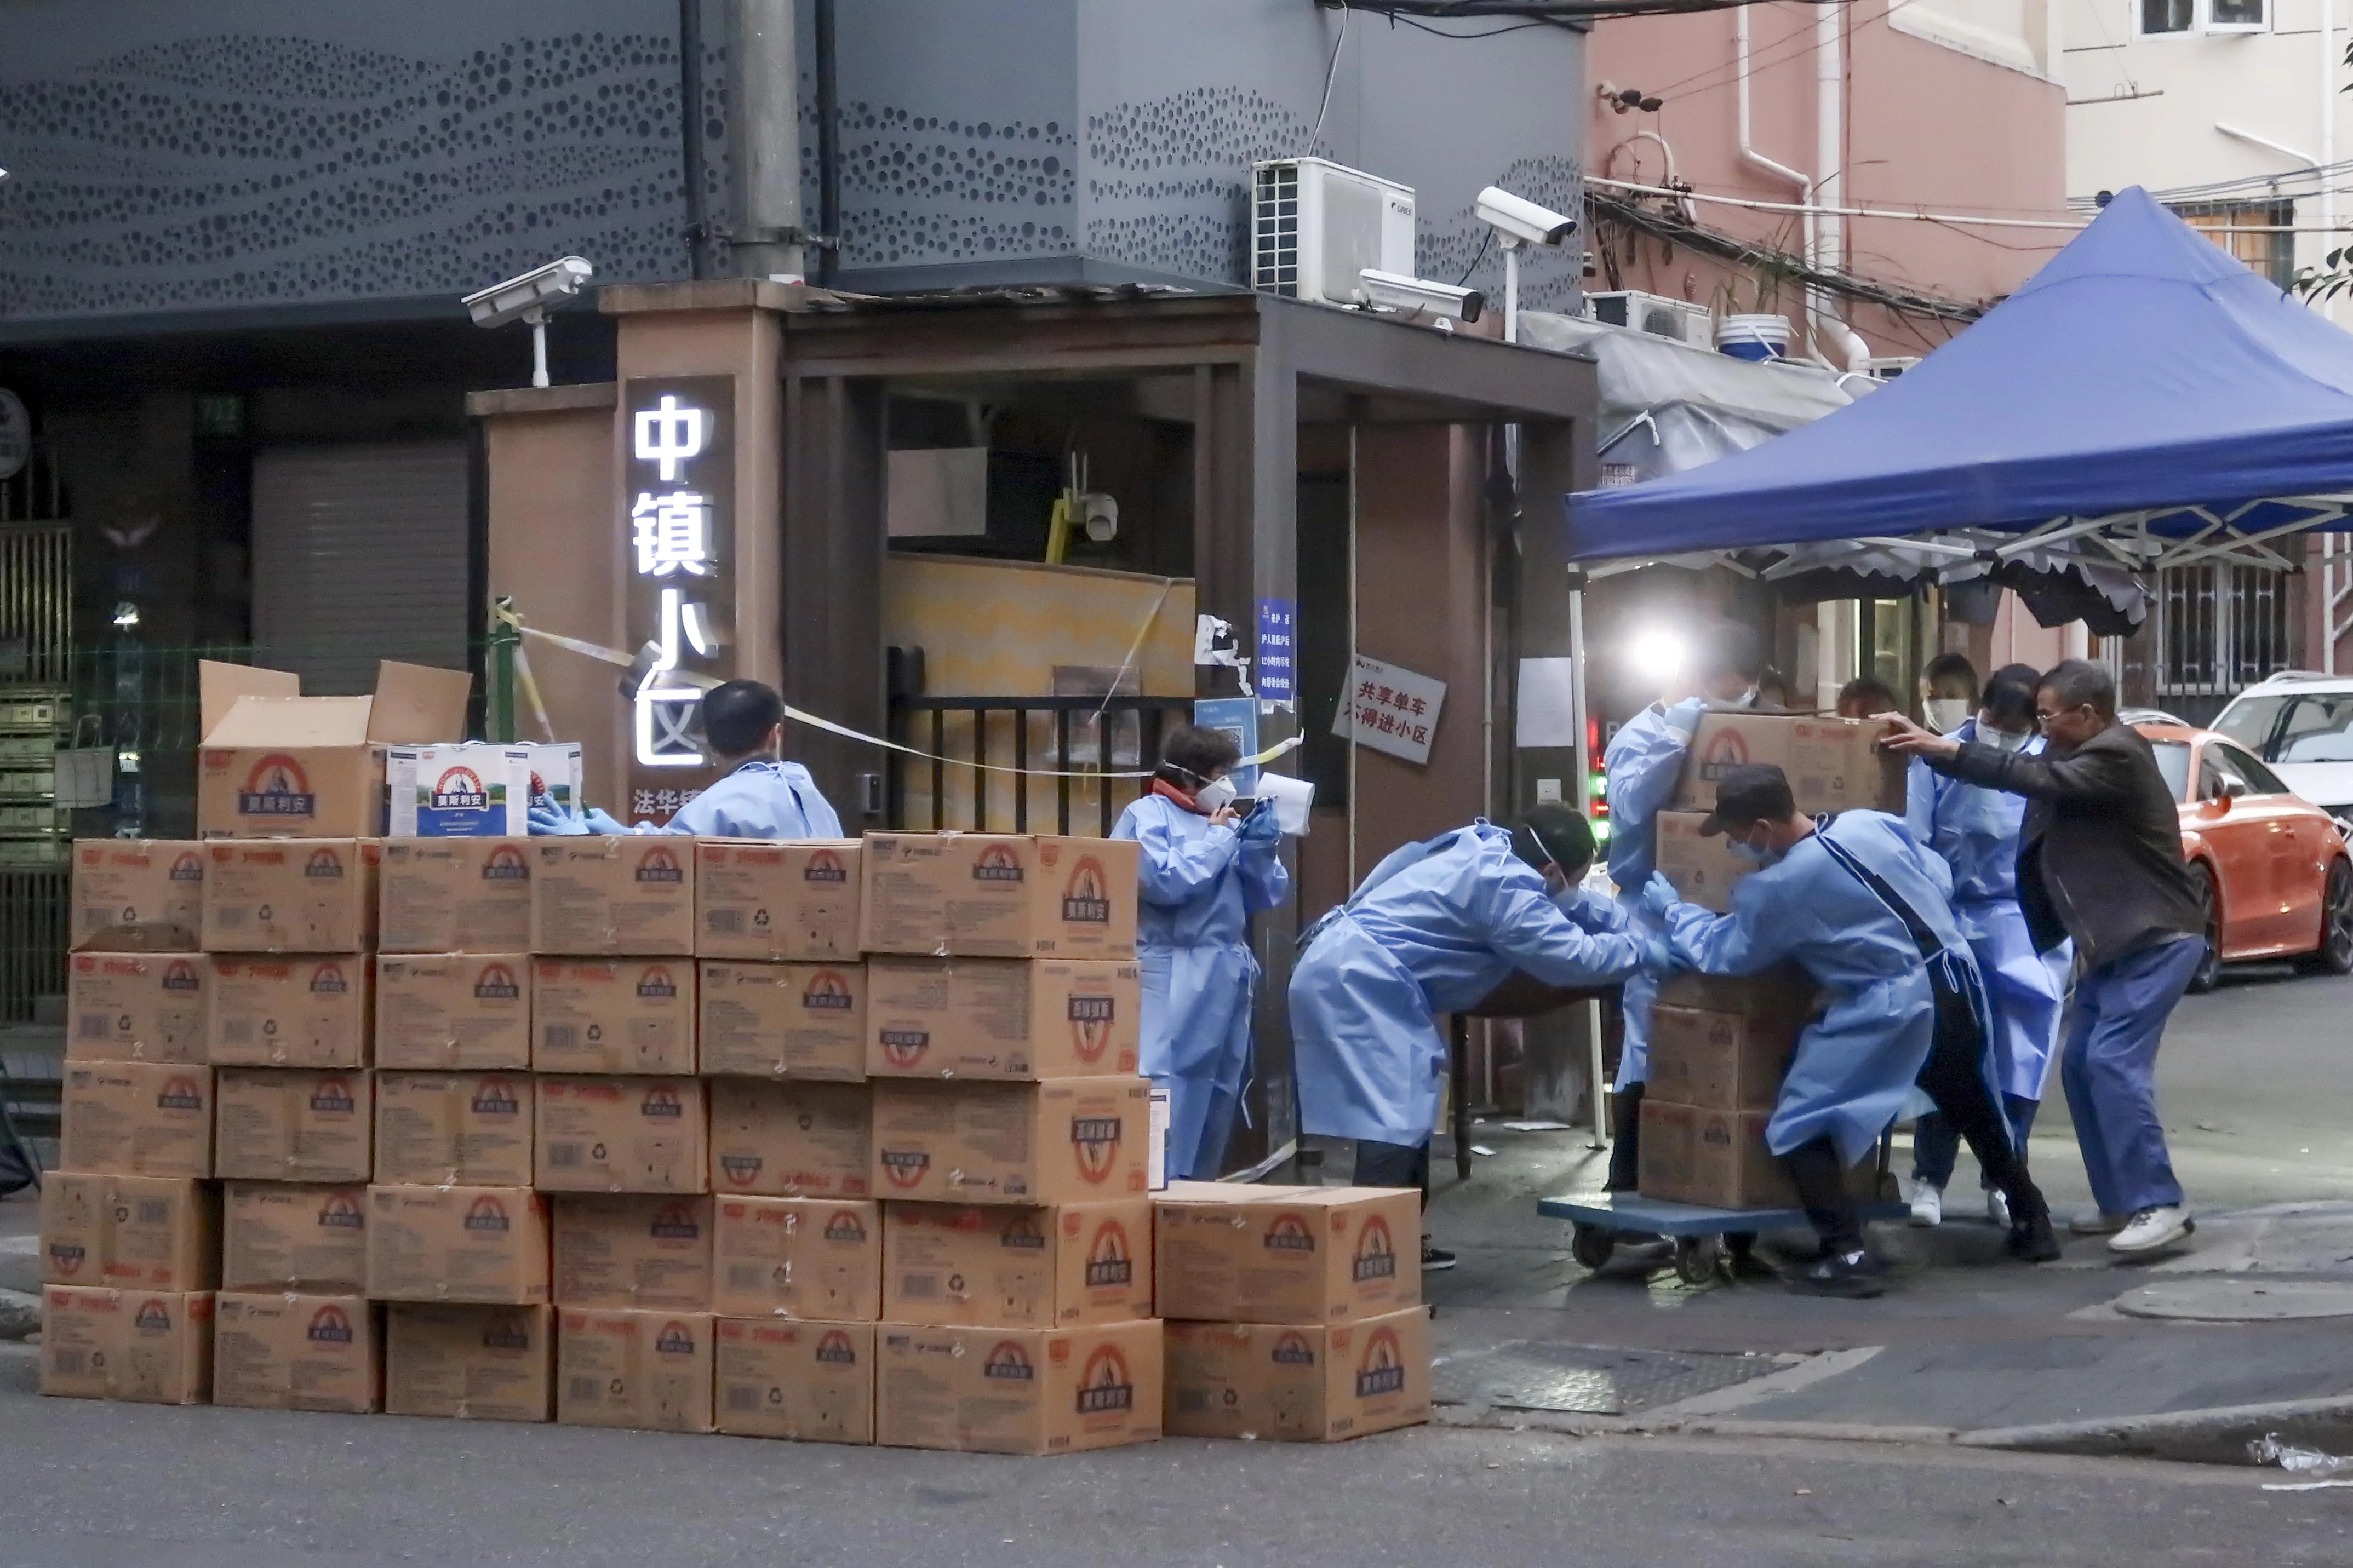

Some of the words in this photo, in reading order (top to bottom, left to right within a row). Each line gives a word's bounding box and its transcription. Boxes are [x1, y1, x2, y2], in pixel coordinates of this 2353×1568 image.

[632, 394, 706, 765] 中镇小区
[1358, 681, 1427, 717] 共享单车
